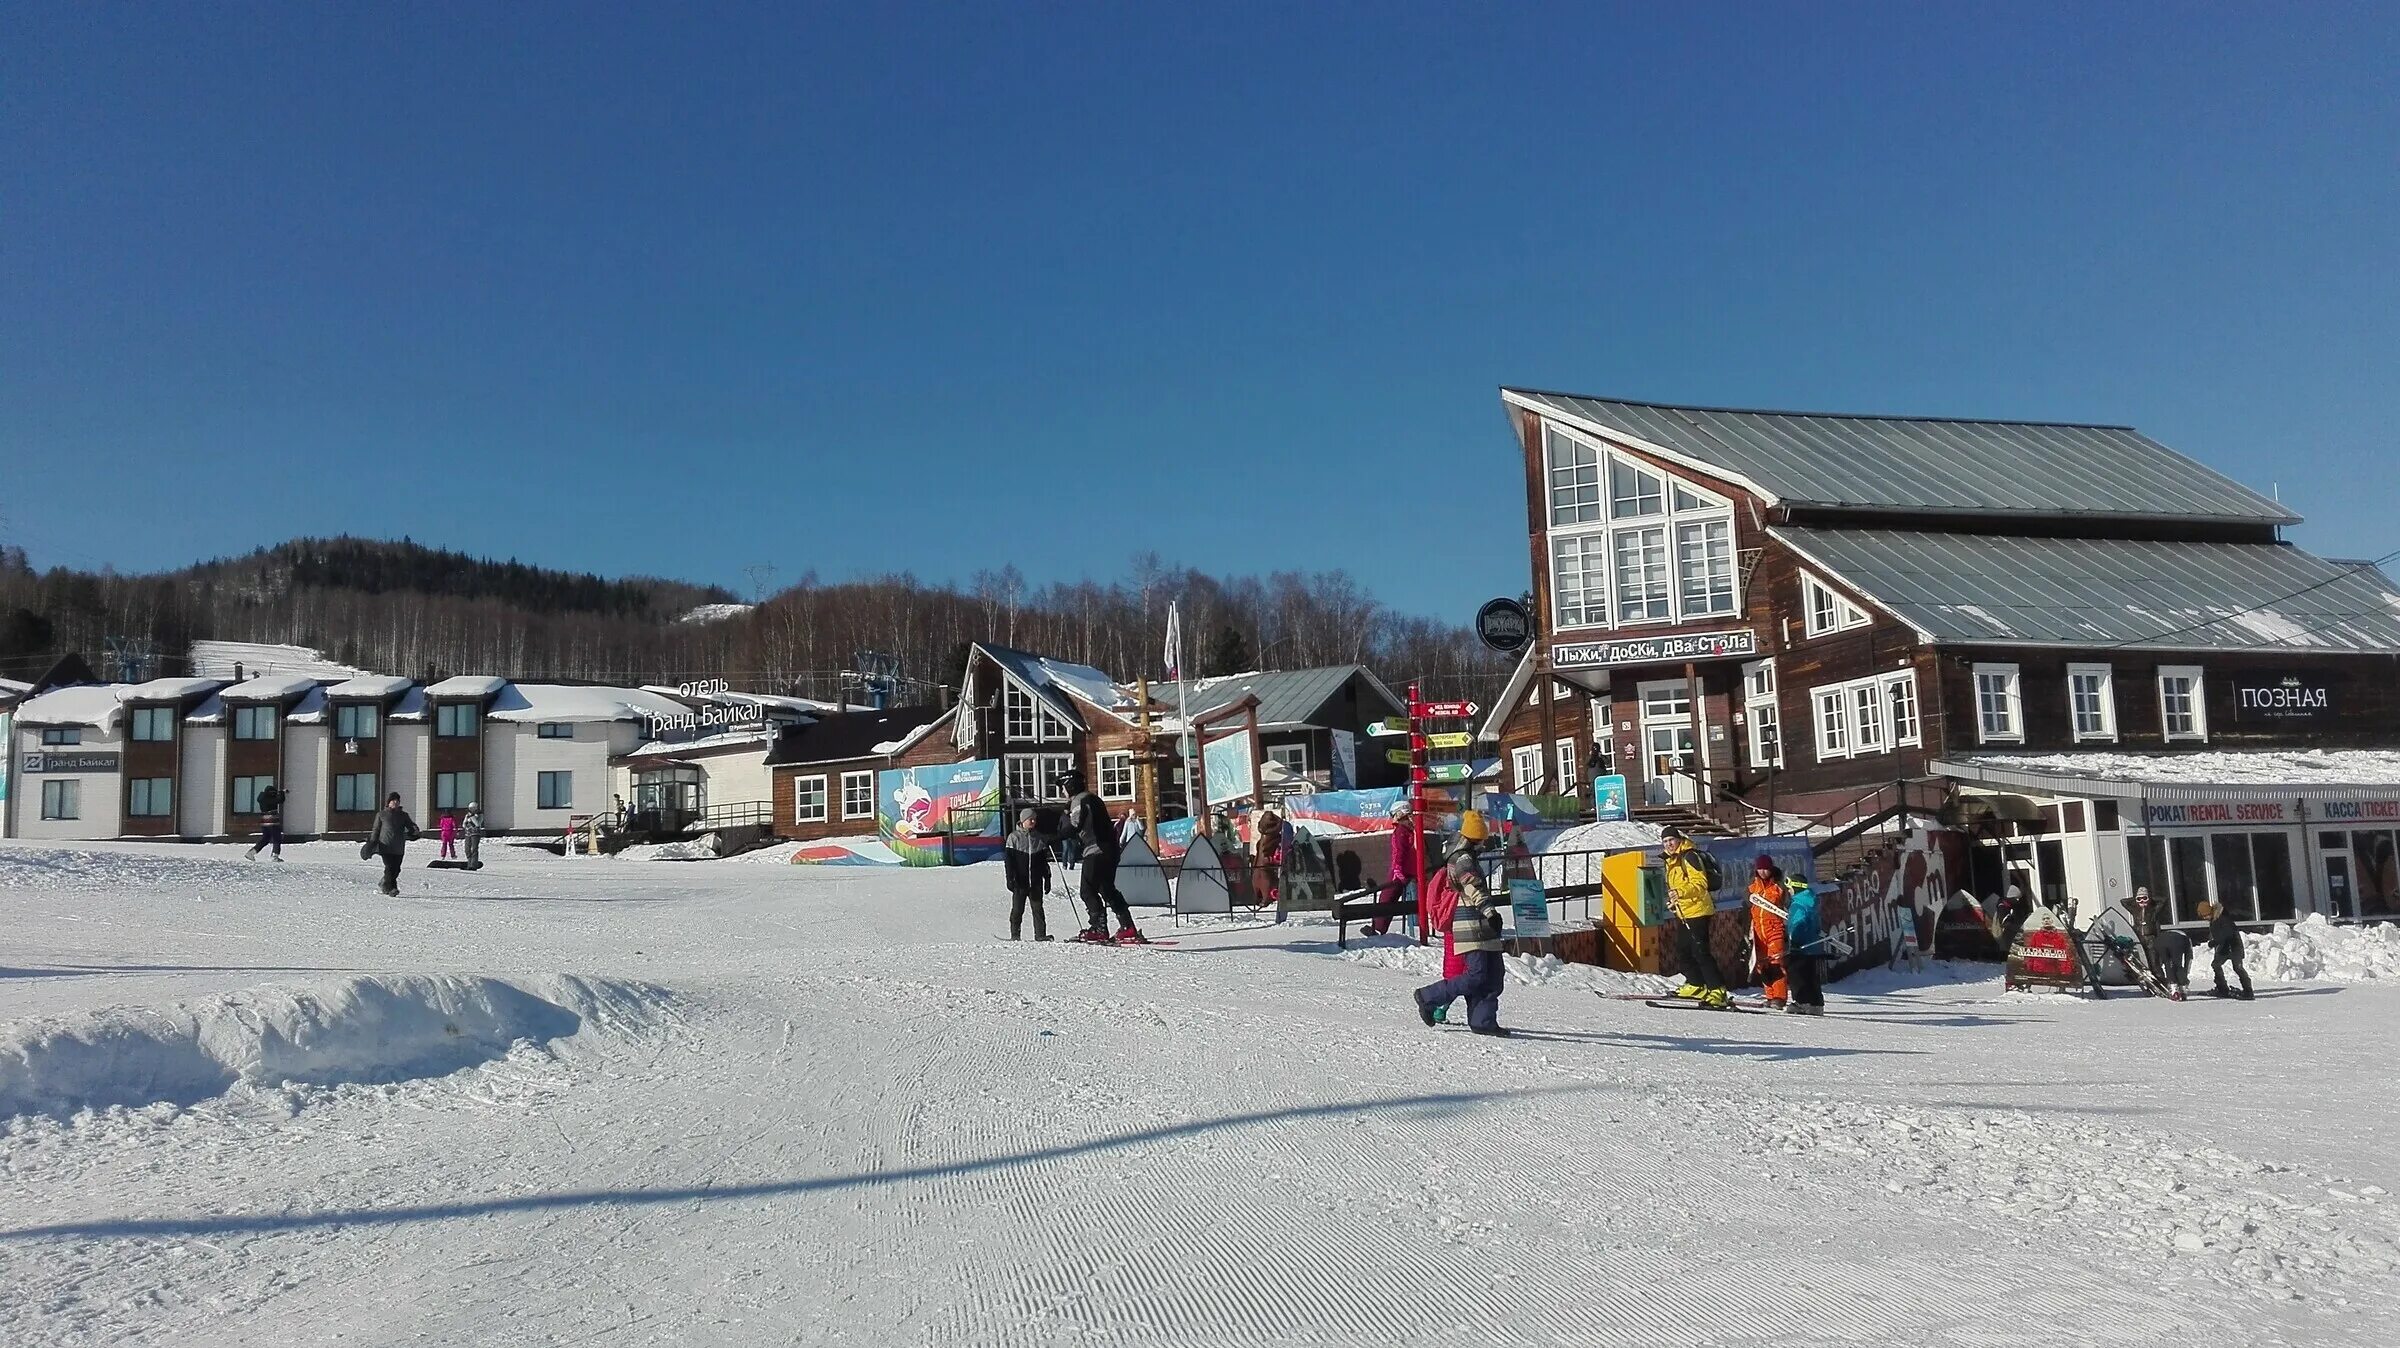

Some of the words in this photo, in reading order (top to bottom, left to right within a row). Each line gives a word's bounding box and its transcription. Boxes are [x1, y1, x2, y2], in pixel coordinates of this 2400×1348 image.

[679, 677, 729, 698] отель
[2241, 688, 2328, 707] ПОЗНАЯ
[643, 712, 696, 739] Гранд
[702, 701, 763, 726] Байкал
[79, 757, 115, 768] Байкал
[949, 791, 973, 809] ТОЧКА
[2236, 803, 2284, 820] SERVICE
